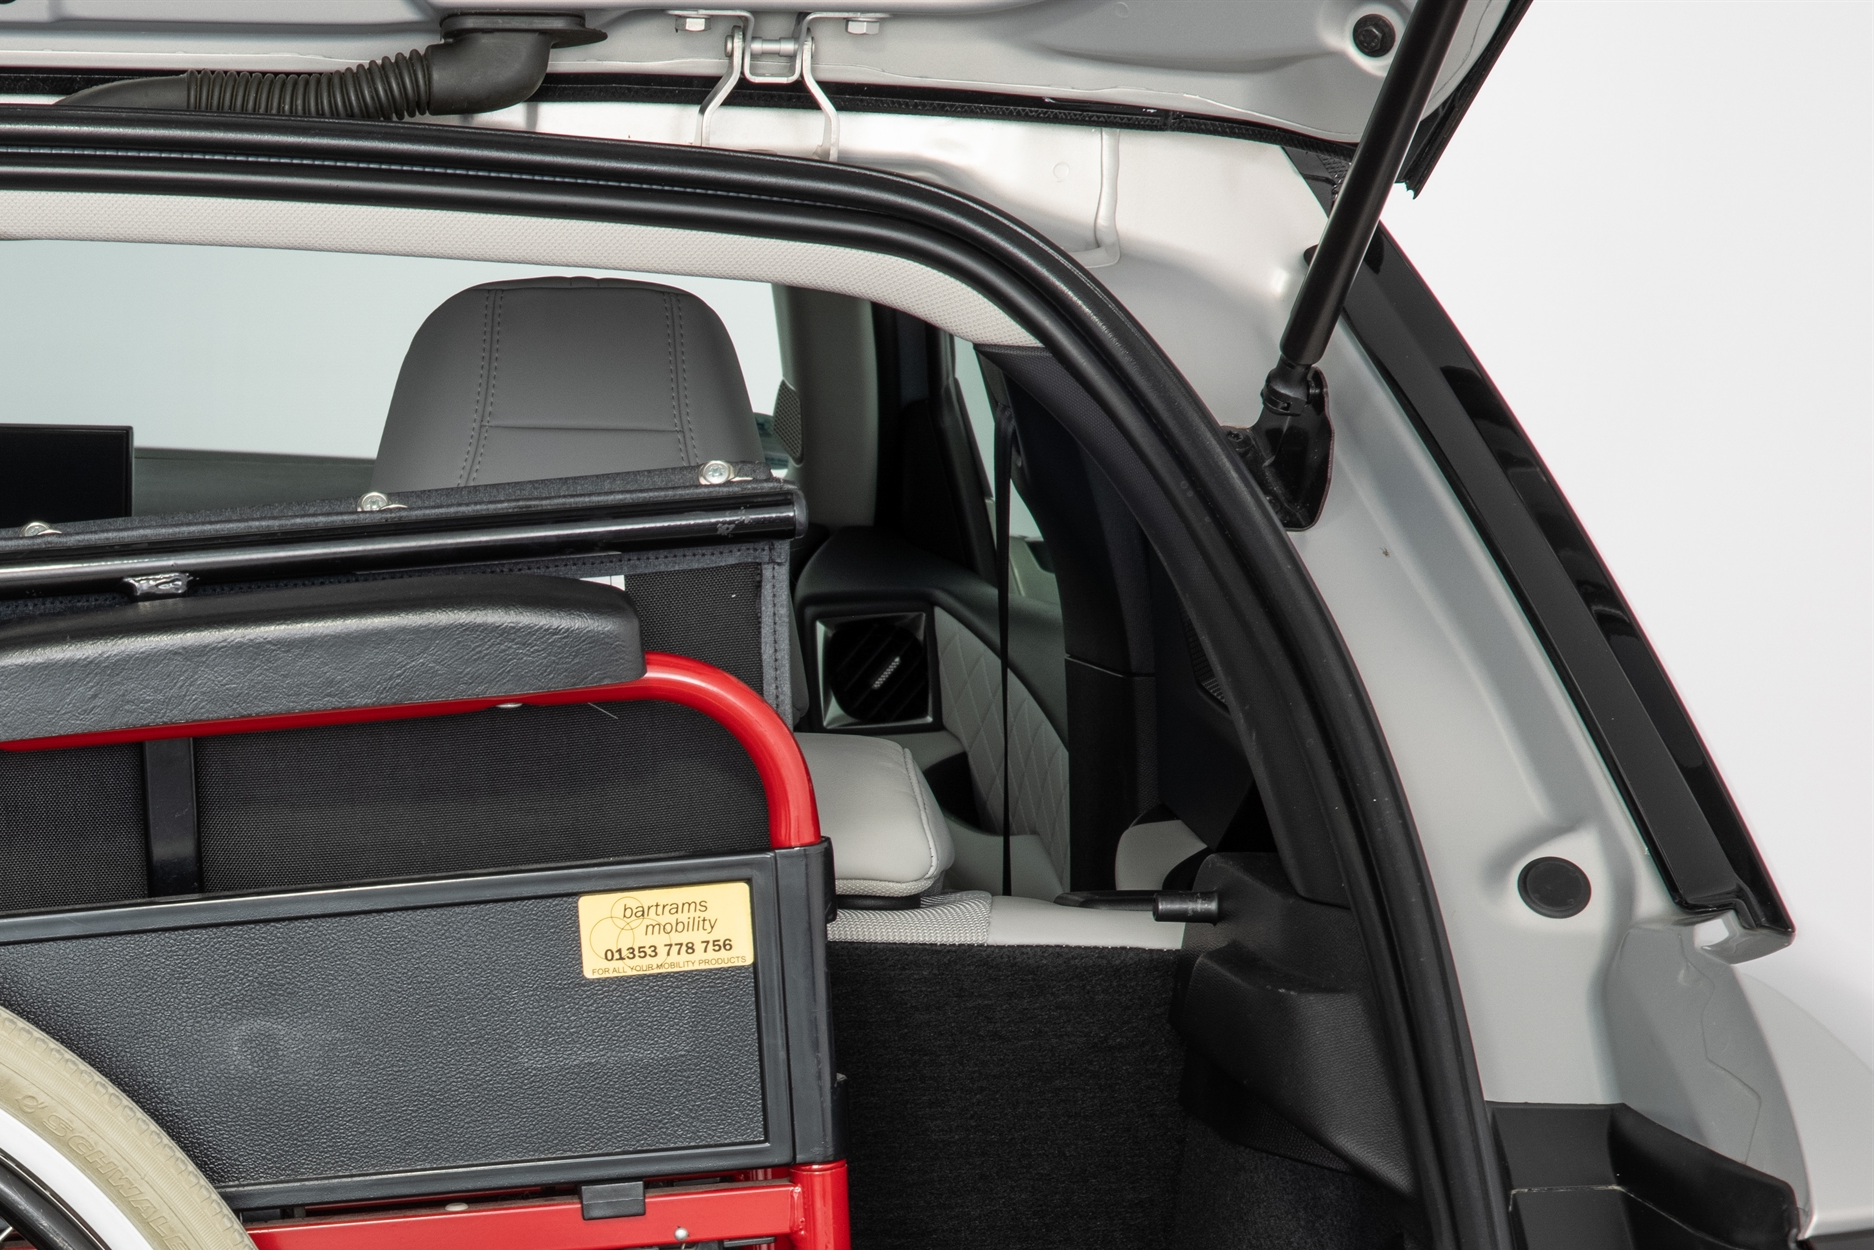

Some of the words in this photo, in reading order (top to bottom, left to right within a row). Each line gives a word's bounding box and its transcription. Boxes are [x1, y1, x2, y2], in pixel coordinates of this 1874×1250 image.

[623, 900, 708, 919] bartrams
[645, 916, 718, 936] mobility
[604, 944, 658, 962] 01353
[664, 941, 696, 957] 778
[701, 938, 733, 953] 756
[592, 968, 609, 976] FOR
[611, 966, 627, 974] ALL
[630, 963, 654, 972] YOUR
[656, 960, 696, 970] MOBILITY
[698, 956, 747, 967] PRODUCTS
